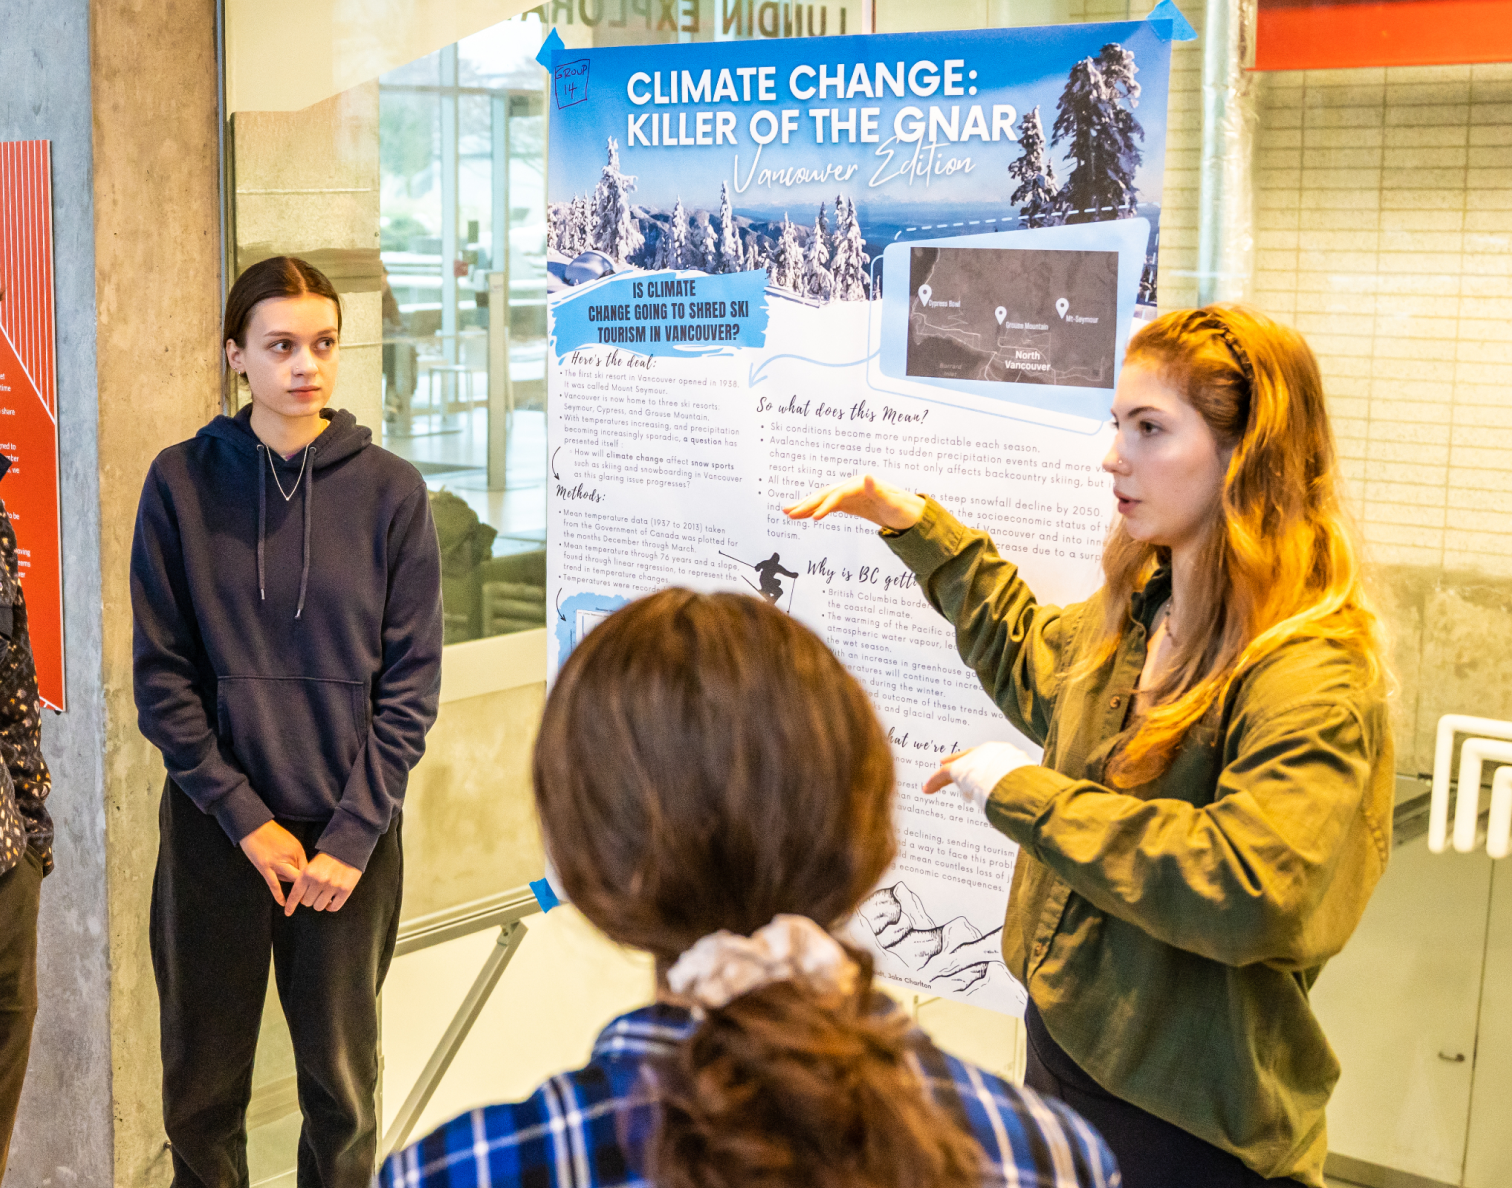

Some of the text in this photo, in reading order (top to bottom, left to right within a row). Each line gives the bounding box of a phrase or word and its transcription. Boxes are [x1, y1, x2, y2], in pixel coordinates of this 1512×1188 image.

[555, 64, 588, 80] GROUP
[627, 58, 978, 105] CLIMATE CHANGE:
[564, 82, 578, 99] 14
[627, 104, 1018, 146] KILLER OF THE GNAR
[733, 134, 976, 193] Vancouver Edition
[633, 280, 696, 298] IS CLIMATE
[588, 300, 748, 322] CHANGE GOING TO SHRED SKI
[598, 324, 740, 343] TOURISM IN VANCOUVER?
[1025, 322, 1048, 330] Mountain
[571, 349, 656, 370] Here's the deal:
[1005, 361, 1051, 371] Vancouver
[1015, 351, 1040, 360] North
[757, 395, 929, 425] So what does this Mean?
[770, 420, 1040, 453] Ski conditions become more unpredictable each season.
[574, 448, 589, 456] How
[591, 449, 603, 458] will
[606, 450, 633, 460] climate
[635, 453, 663, 464] change
[666, 455, 688, 465] affect
[711, 461, 734, 469] sports
[769, 434, 819, 448] Avalanches
[822, 440, 861, 452] increase
[864, 442, 881, 453] due
[885, 445, 894, 454] to
[898, 446, 932, 457] sudden
[936, 451, 1001, 463] precipitation
[1005, 457, 1037, 466] events
[1041, 458, 1060, 468] and
[1065, 462, 1090, 470] more
[769, 448, 1103, 487] changes in temperature. This not only affects backcountry skiing, but
[556, 483, 605, 503] Methods:
[940, 492, 966, 506] steep
[970, 496, 1010, 507] snowfall
[1014, 498, 1052, 511] decline
[1056, 502, 1068, 516] by
[1072, 504, 1103, 516] 2050.
[957, 508, 1100, 531] the socioeconomic status of
[807, 557, 836, 584] Why
[842, 568, 853, 581] is
[859, 566, 879, 584] BC
[827, 600, 912, 618] the coastal climate.
[828, 612, 942, 634] The warming of the Pacific
[861, 653, 897, 665] increase
[901, 658, 908, 666] in
[911, 662, 961, 674] greenhouse
[885, 668, 952, 685] will continue to
[884, 705, 970, 725] and glacial volume.
[888, 727, 946, 753] hat we're
[903, 827, 1016, 857] declining, sending tourism
[909, 855, 1004, 879] mean countless loss of
[917, 844, 934, 855] way
[936, 846, 945, 855] to
[948, 848, 967, 859] face
[971, 853, 985, 863] this
[988, 859, 1014, 869] probl
[899, 864, 1004, 892] economic consequences.
[905, 977, 931, 990] Charlton
